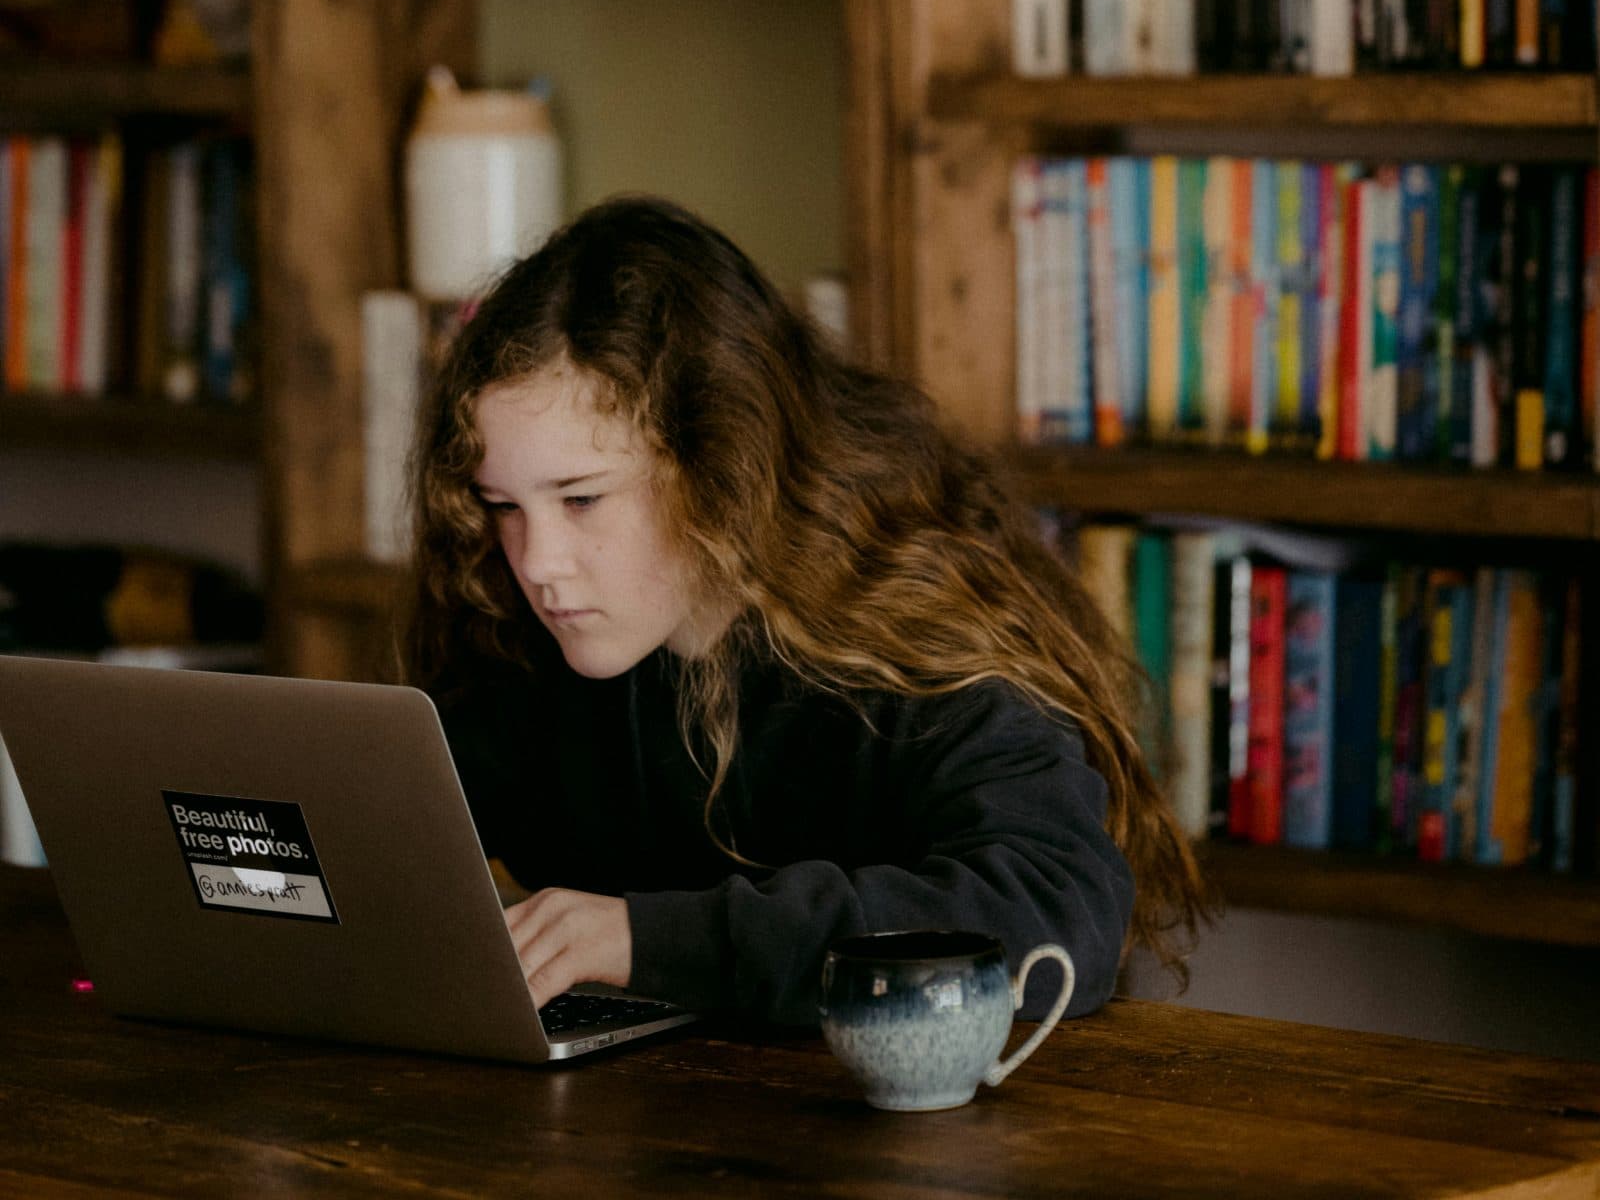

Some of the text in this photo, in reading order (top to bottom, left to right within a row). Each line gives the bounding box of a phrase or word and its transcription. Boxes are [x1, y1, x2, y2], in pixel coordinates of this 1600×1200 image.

[172, 804, 275, 837] Beautiful,
[180, 827, 309, 860] free photos.
